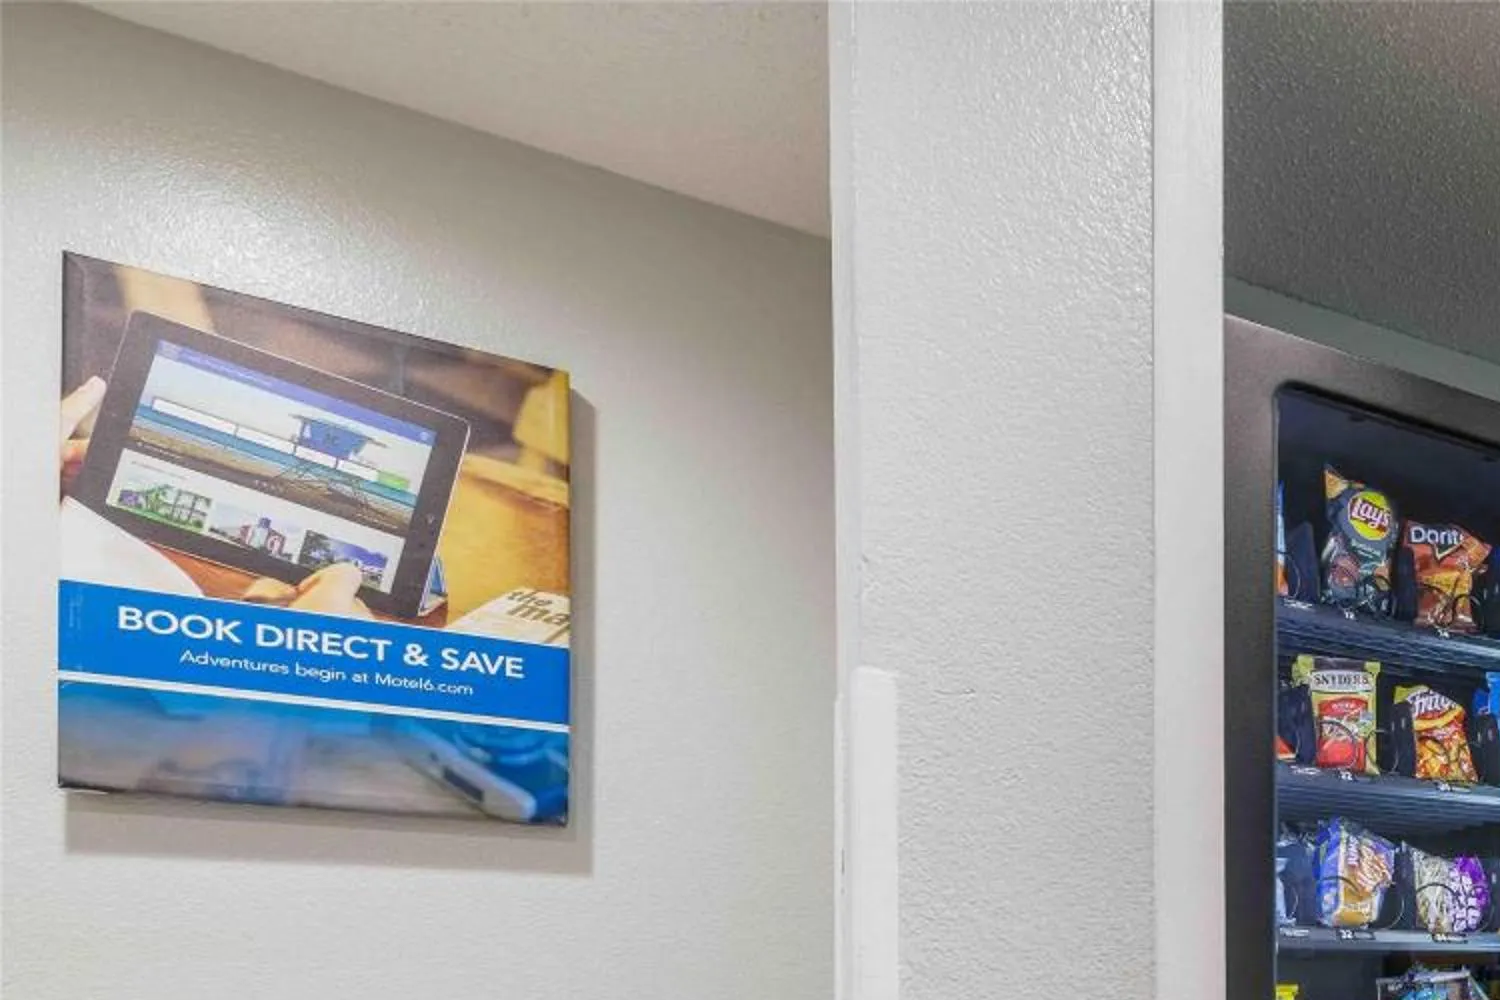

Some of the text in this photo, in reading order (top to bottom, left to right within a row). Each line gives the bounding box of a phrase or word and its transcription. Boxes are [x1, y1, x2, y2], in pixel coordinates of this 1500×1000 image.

[1410, 525, 1464, 545] Dorit
[117, 605, 243, 645] BOOK
[255, 623, 393, 662] DIRECT
[402, 643, 430, 667] &
[440, 647, 526, 679] SAVE
[179, 649, 474, 696] Adventures begin at Motel6.com
